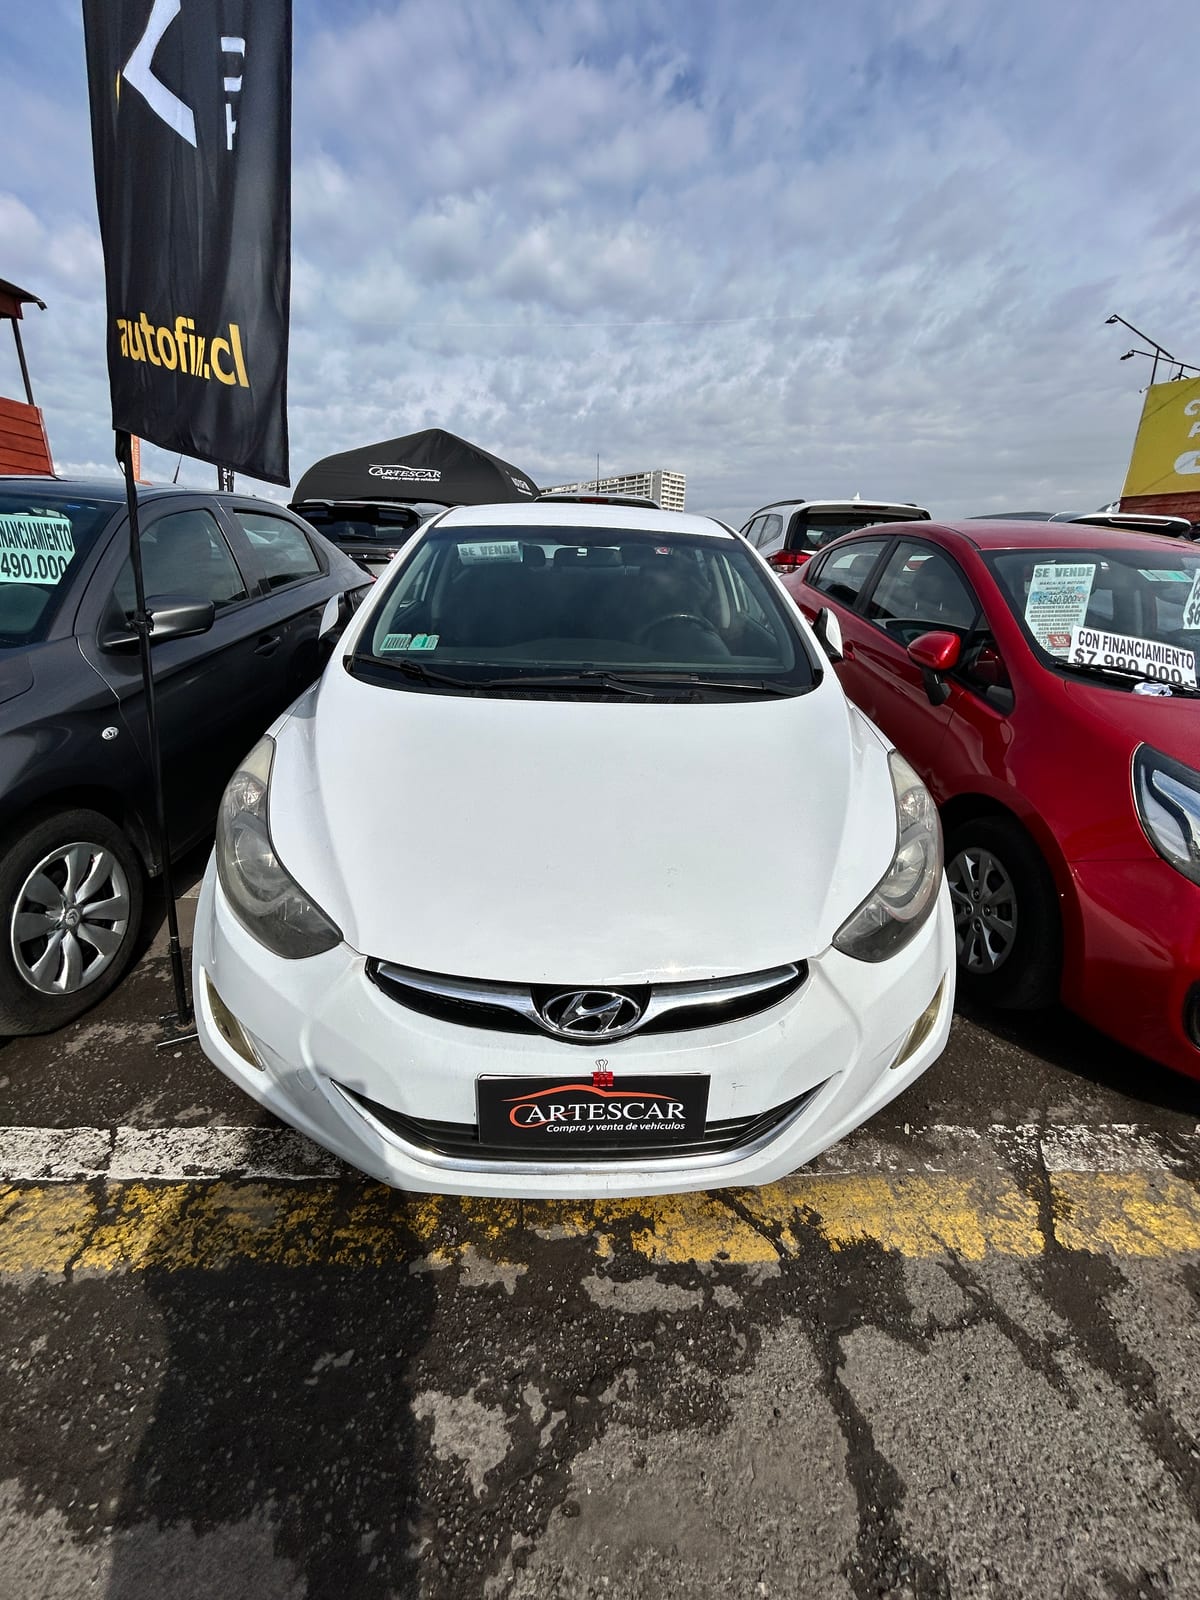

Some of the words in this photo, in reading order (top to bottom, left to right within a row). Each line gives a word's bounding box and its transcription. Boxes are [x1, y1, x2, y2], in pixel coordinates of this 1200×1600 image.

[460, 547, 475, 557] SE
[480, 545, 517, 555] VENDE
[1035, 568, 1050, 578] SE
[1055, 567, 1094, 577] VENDE
[1078, 630, 1100, 650] CON
[1102, 635, 1194, 670] FINANCIAMIENTO
[509, 1102, 686, 1128] CARTESCAR
[546, 1123, 586, 1133] Compra
[588, 1124, 595, 1133] y
[596, 1123, 625, 1132] venta
[626, 1122, 638, 1131] de
[640, 1121, 686, 1131] vehículos
